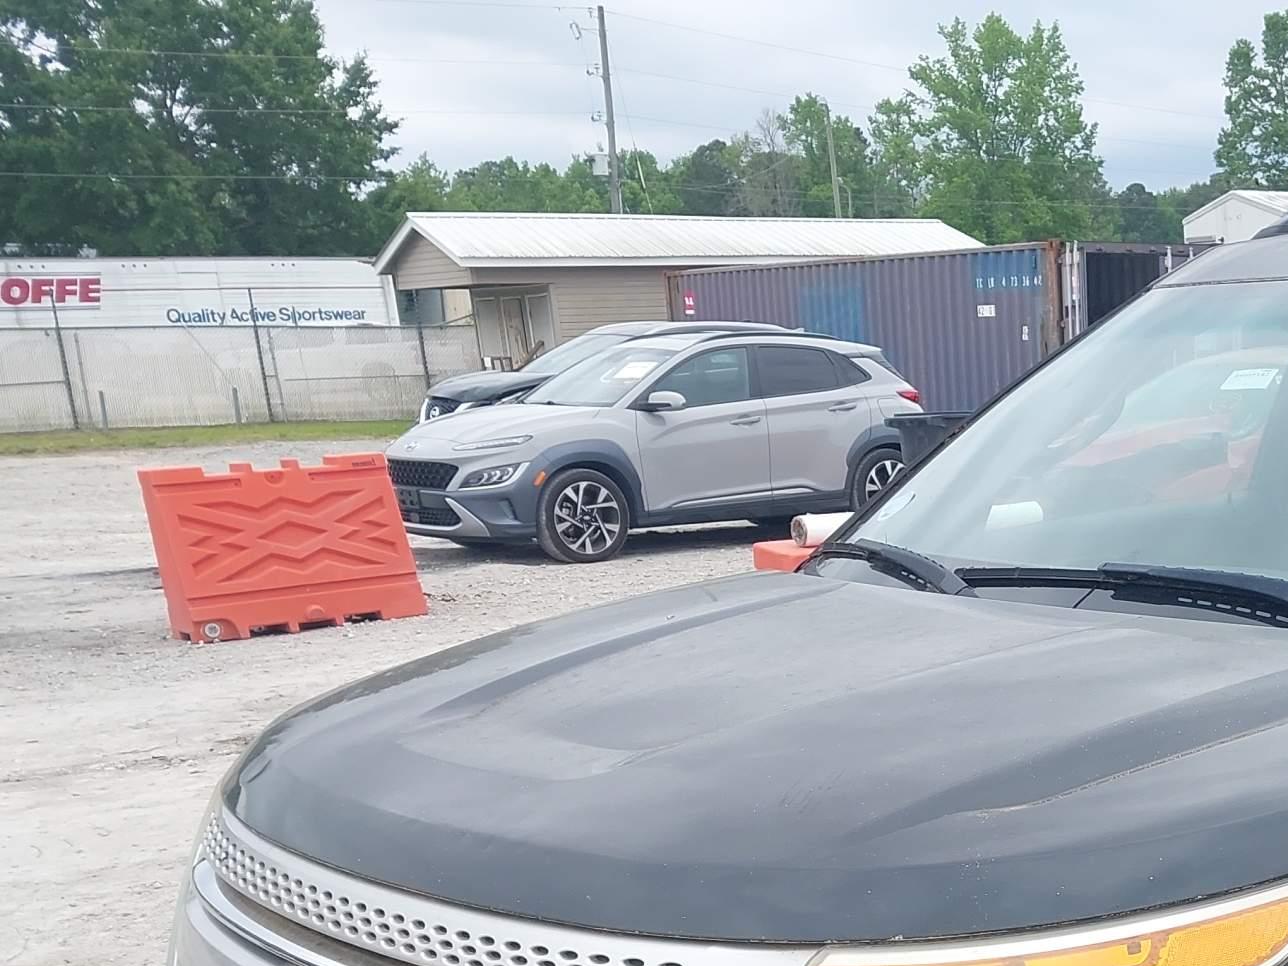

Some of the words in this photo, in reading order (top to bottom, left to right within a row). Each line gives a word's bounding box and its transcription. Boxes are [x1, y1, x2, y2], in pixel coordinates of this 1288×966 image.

[1, 278, 101, 305] OFFE
[166, 308, 227, 325] Quality
[230, 307, 277, 323] Active
[278, 306, 367, 323] Sportswear
